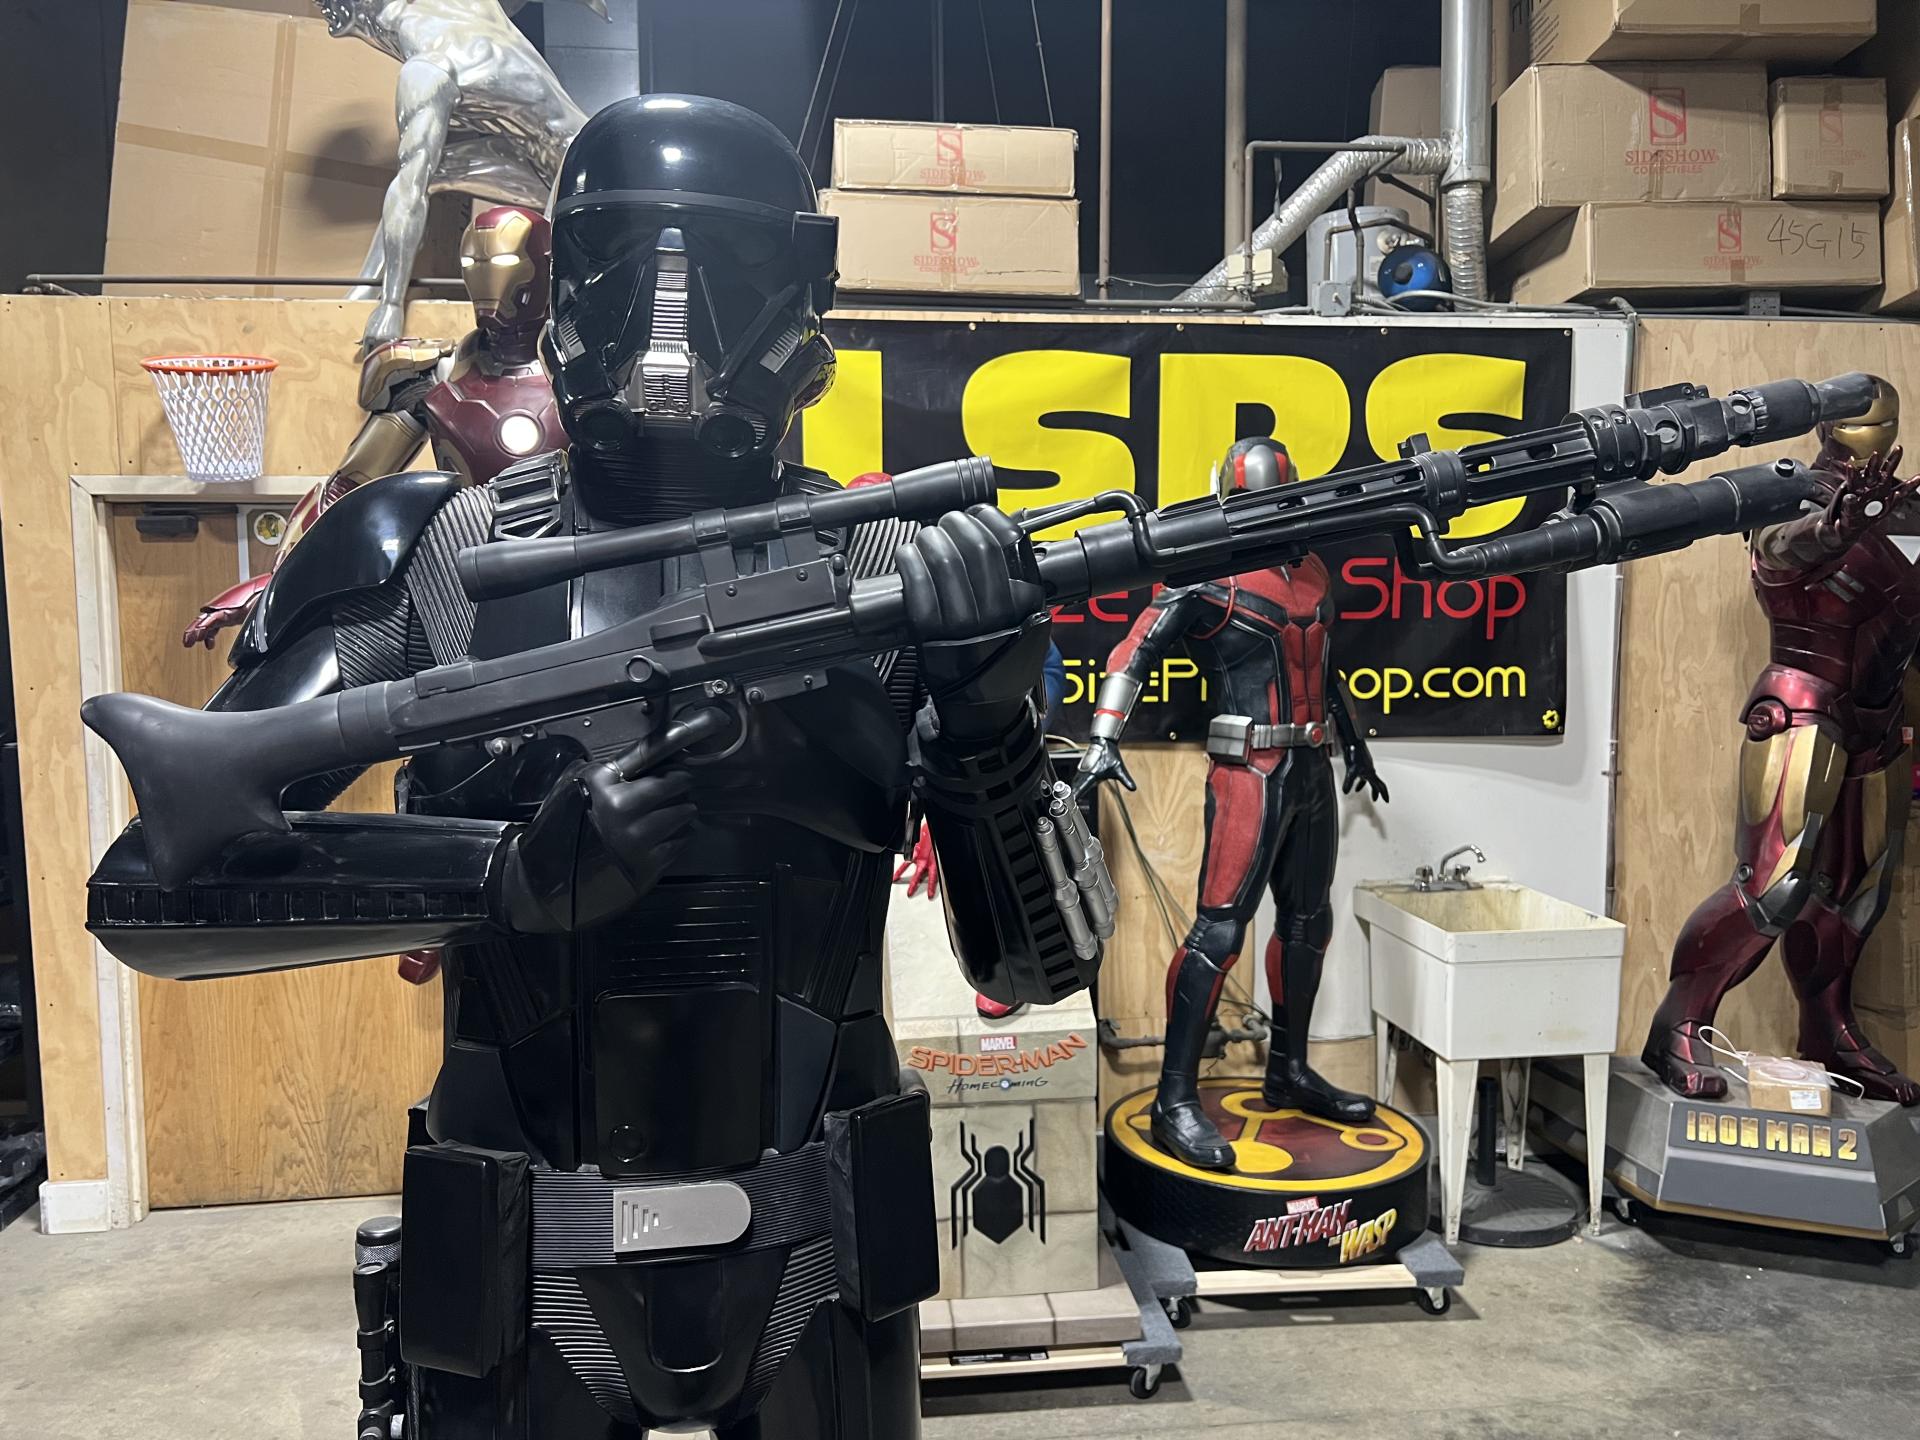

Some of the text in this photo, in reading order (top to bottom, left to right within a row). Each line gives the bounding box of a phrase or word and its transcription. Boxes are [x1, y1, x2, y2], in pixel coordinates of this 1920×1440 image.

[920, 168, 985, 180] SIDEOW
[1625, 149, 1716, 163] SIDESHOW
[1767, 213, 1871, 260] 45G15
[1340, 556, 1527, 640] Shop
[906, 1031, 1088, 1076] SPIDER-MAN
[981, 1037, 1017, 1050] MARVEL
[1686, 1110, 1857, 1160] IRON MAN 2
[1243, 1198, 1353, 1252] ANT-MAN
[1339, 1208, 1398, 1264] WASP
